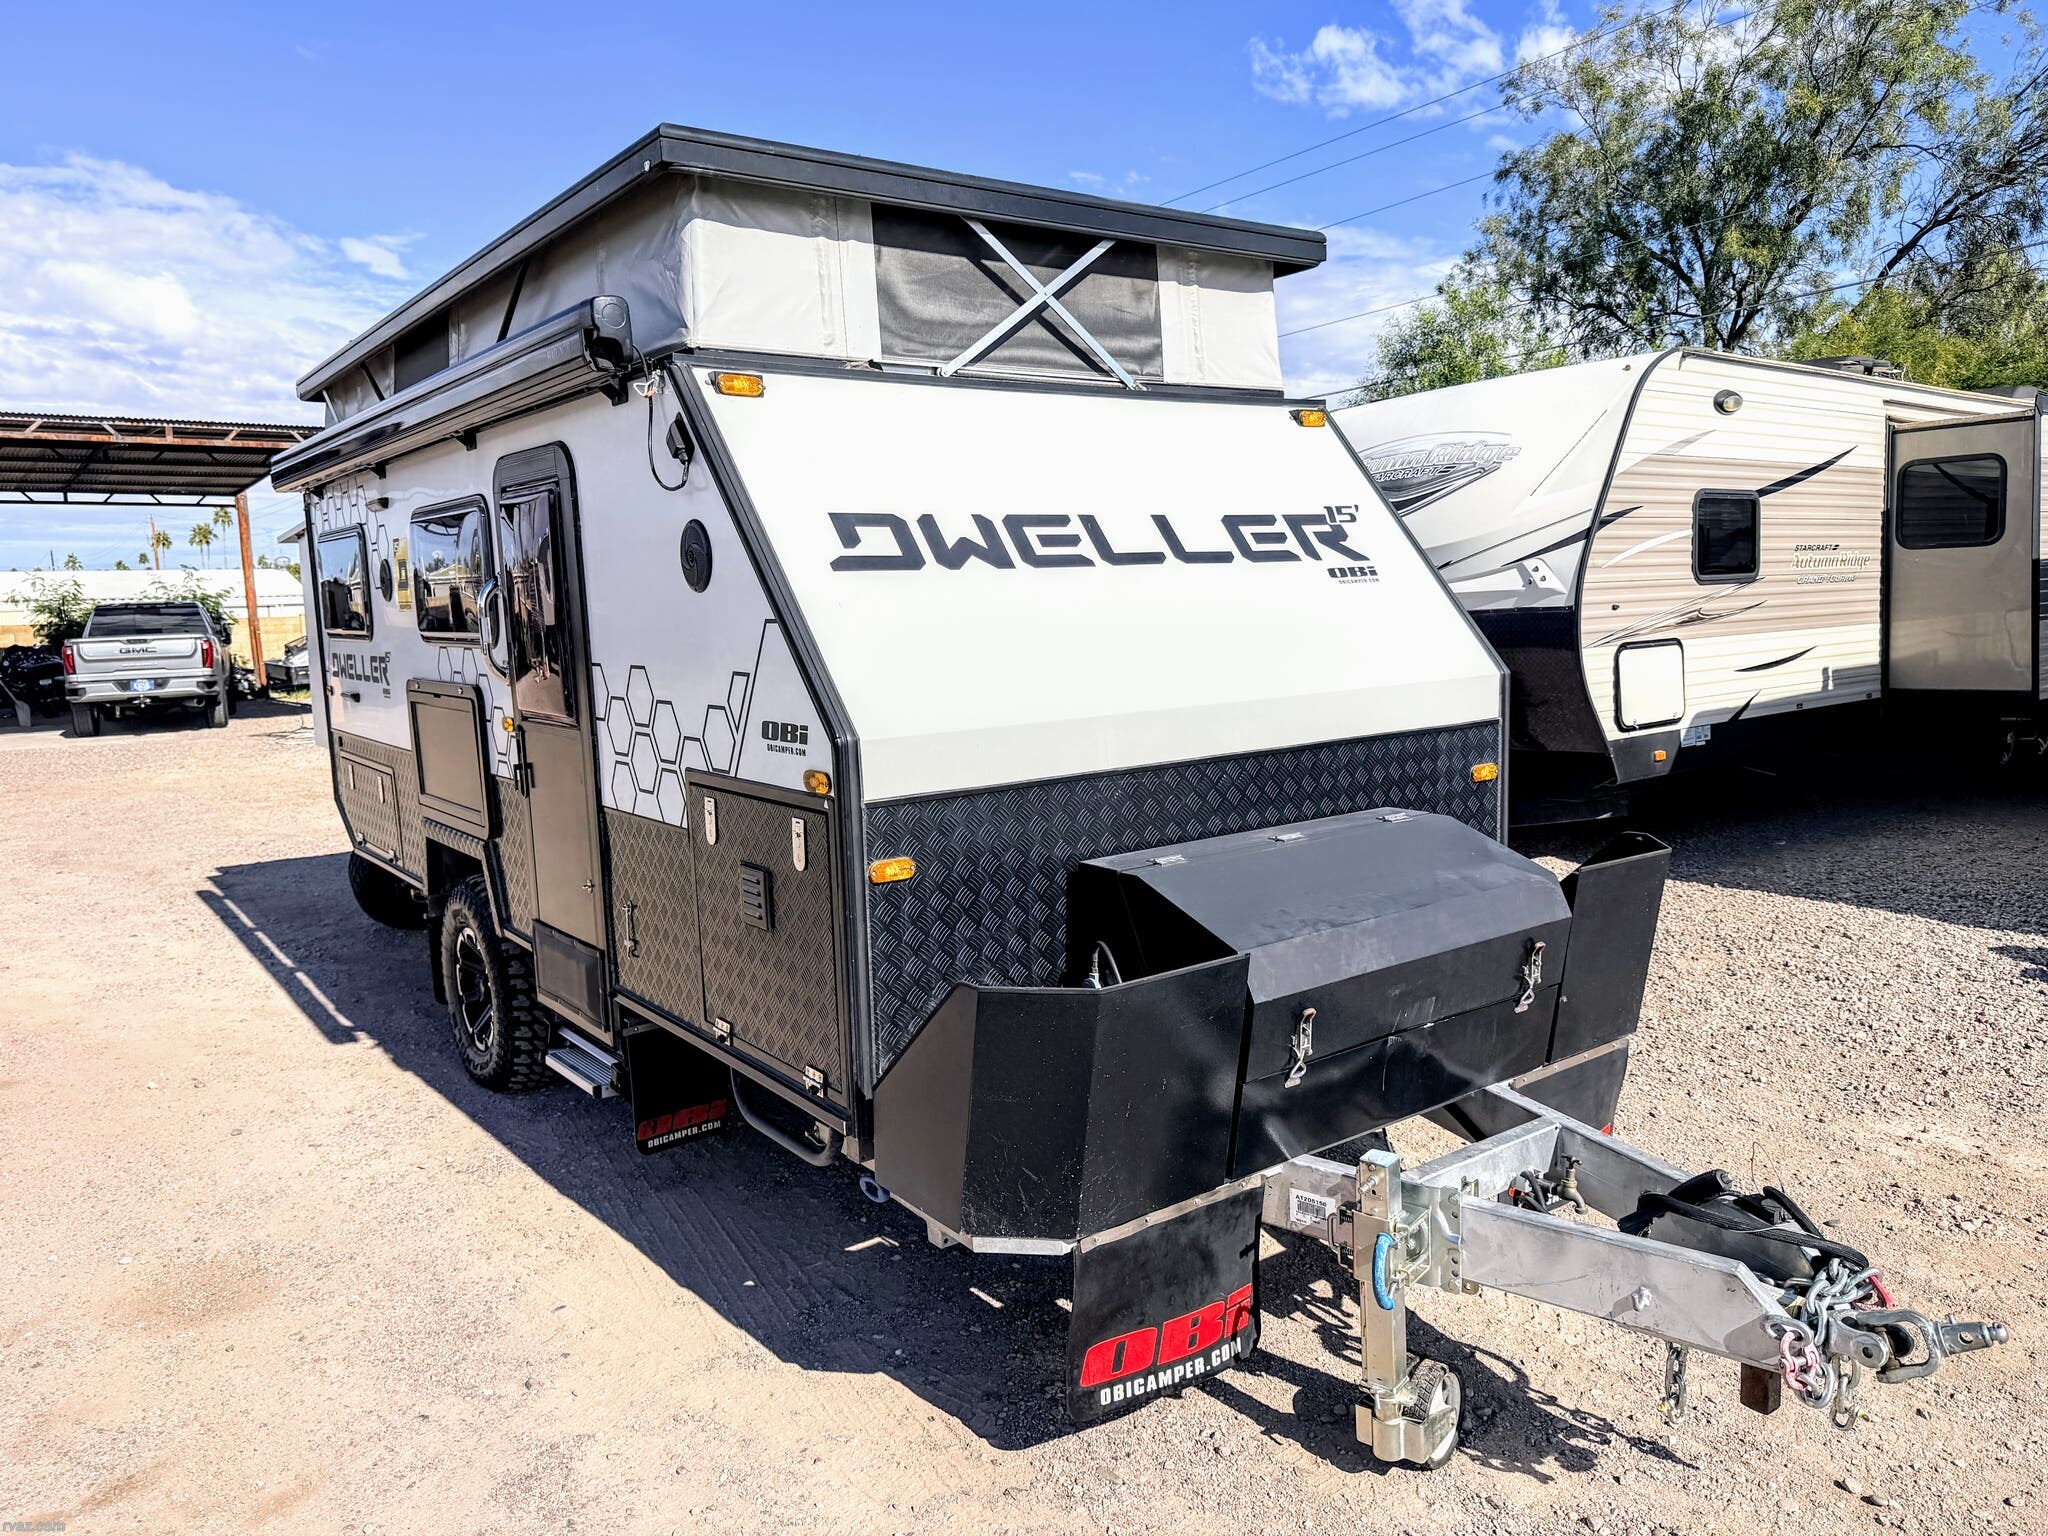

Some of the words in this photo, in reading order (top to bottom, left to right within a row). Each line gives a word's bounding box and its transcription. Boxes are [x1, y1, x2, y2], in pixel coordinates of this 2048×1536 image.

[1426, 440, 1522, 468] Ridge
[1323, 504, 1359, 524] 15'
[828, 512, 1371, 571] DWELLER
[1794, 544, 1834, 552] STARCRAFT
[1792, 554, 1840, 569] Autumn
[1839, 551, 1872, 571] Ridge
[332, 652, 390, 686] DWELLER
[766, 743, 807, 757] OBICAMPER.COM
[647, 1120, 721, 1149] OBICAMPER.COM
[1100, 1337, 1242, 1406] OBICAMPER.COM
